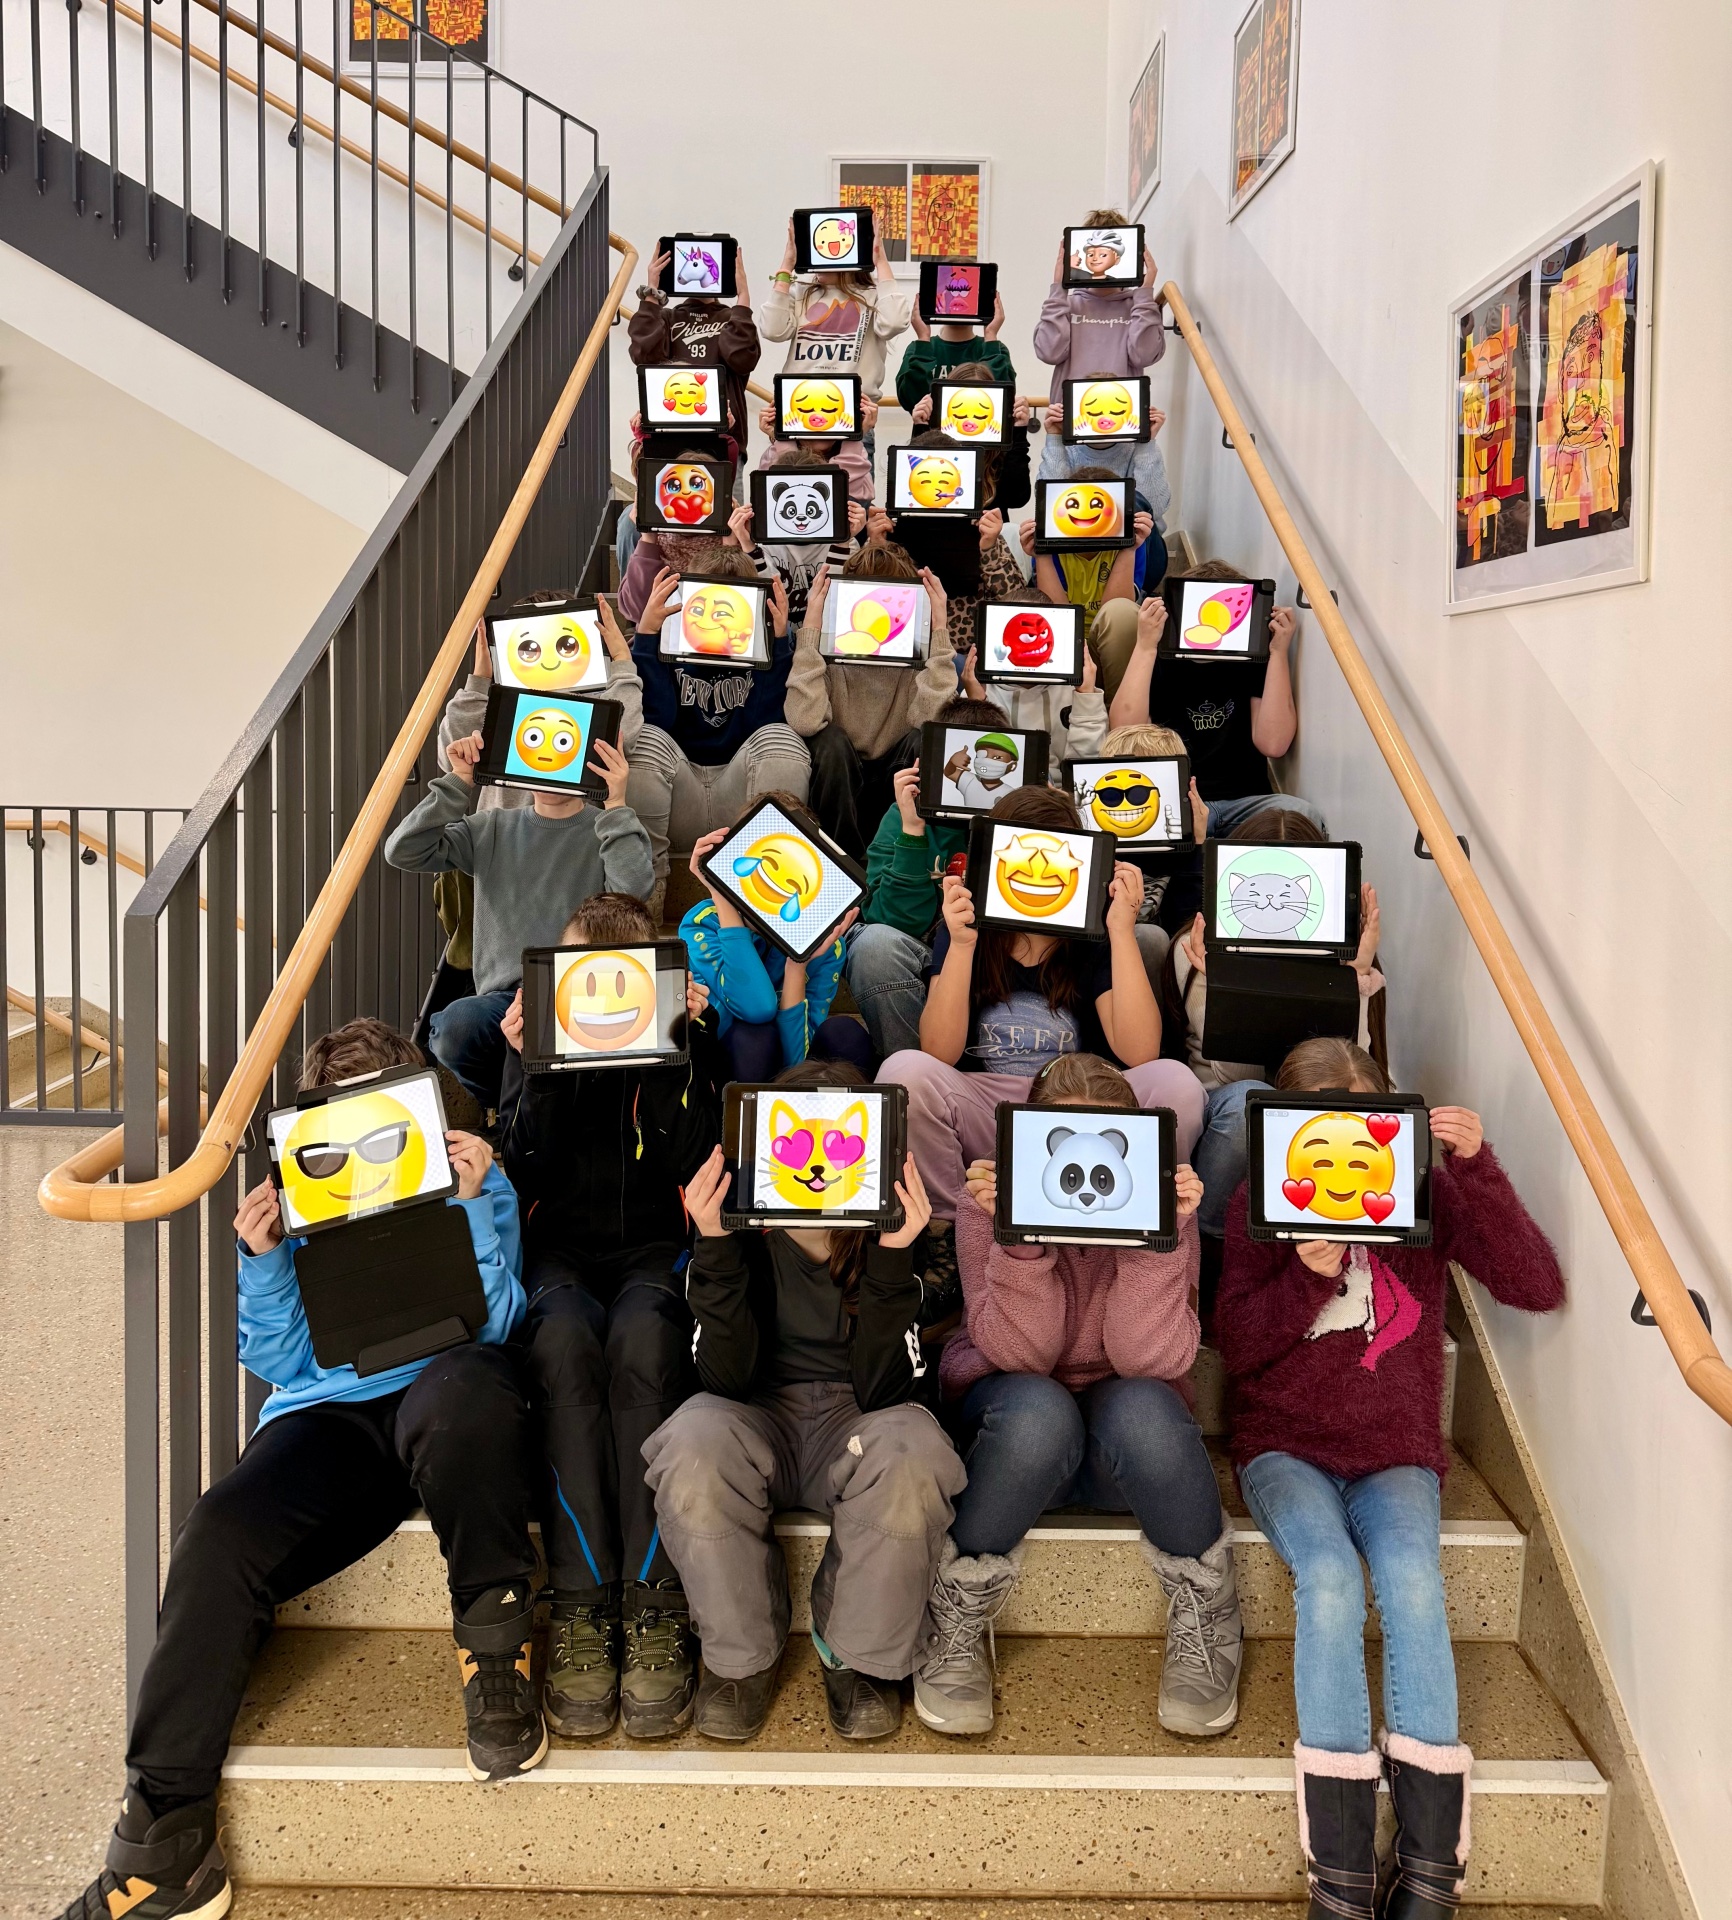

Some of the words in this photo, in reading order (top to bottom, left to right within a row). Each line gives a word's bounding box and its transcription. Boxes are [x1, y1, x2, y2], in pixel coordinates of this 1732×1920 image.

[1070, 313, 1133, 329] Champio
[687, 344, 707, 358] '93
[794, 342, 854, 362] LOVE
[981, 1023, 1073, 1052] KEEP
